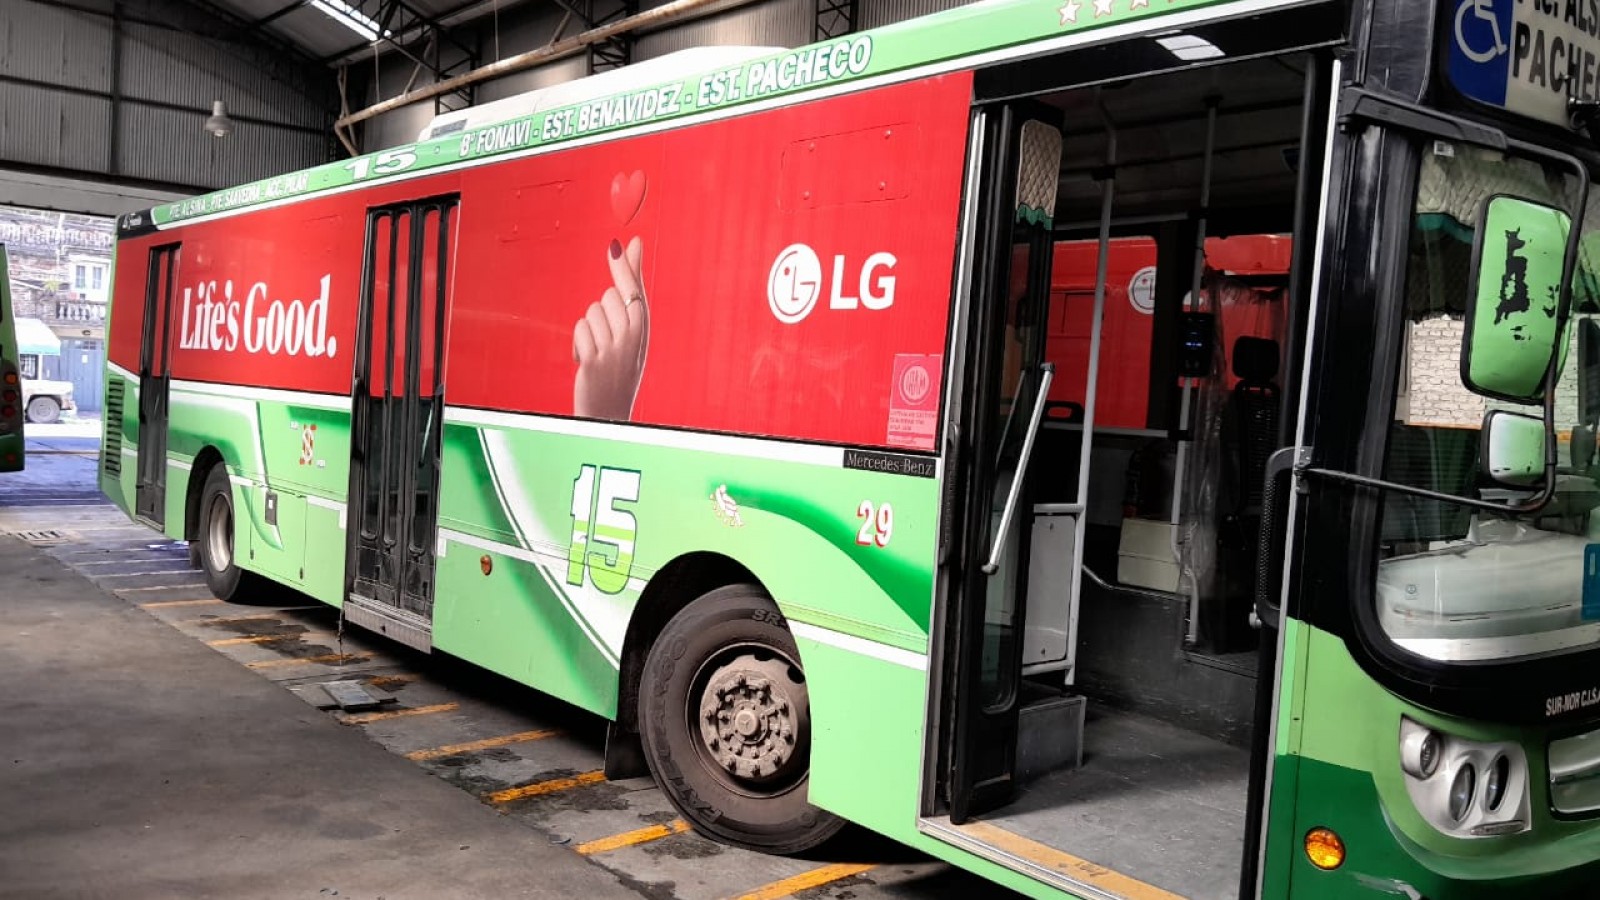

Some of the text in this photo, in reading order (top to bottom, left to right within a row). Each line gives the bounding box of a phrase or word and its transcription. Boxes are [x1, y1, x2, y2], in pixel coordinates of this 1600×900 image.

[477, 118, 531, 154] FONAVI
[541, 108, 574, 141] EST.
[577, 81, 684, 132] BENAVIDEZ
[696, 66, 744, 108] EST.
[745, 34, 874, 97] PACHECO
[343, 145, 417, 180] 15
[829, 251, 897, 311] LG
[179, 273, 337, 358] Life's Good.
[846, 450, 932, 475] Mercedes-Benz
[565, 462, 643, 596] 15
[855, 499, 894, 549] 29
